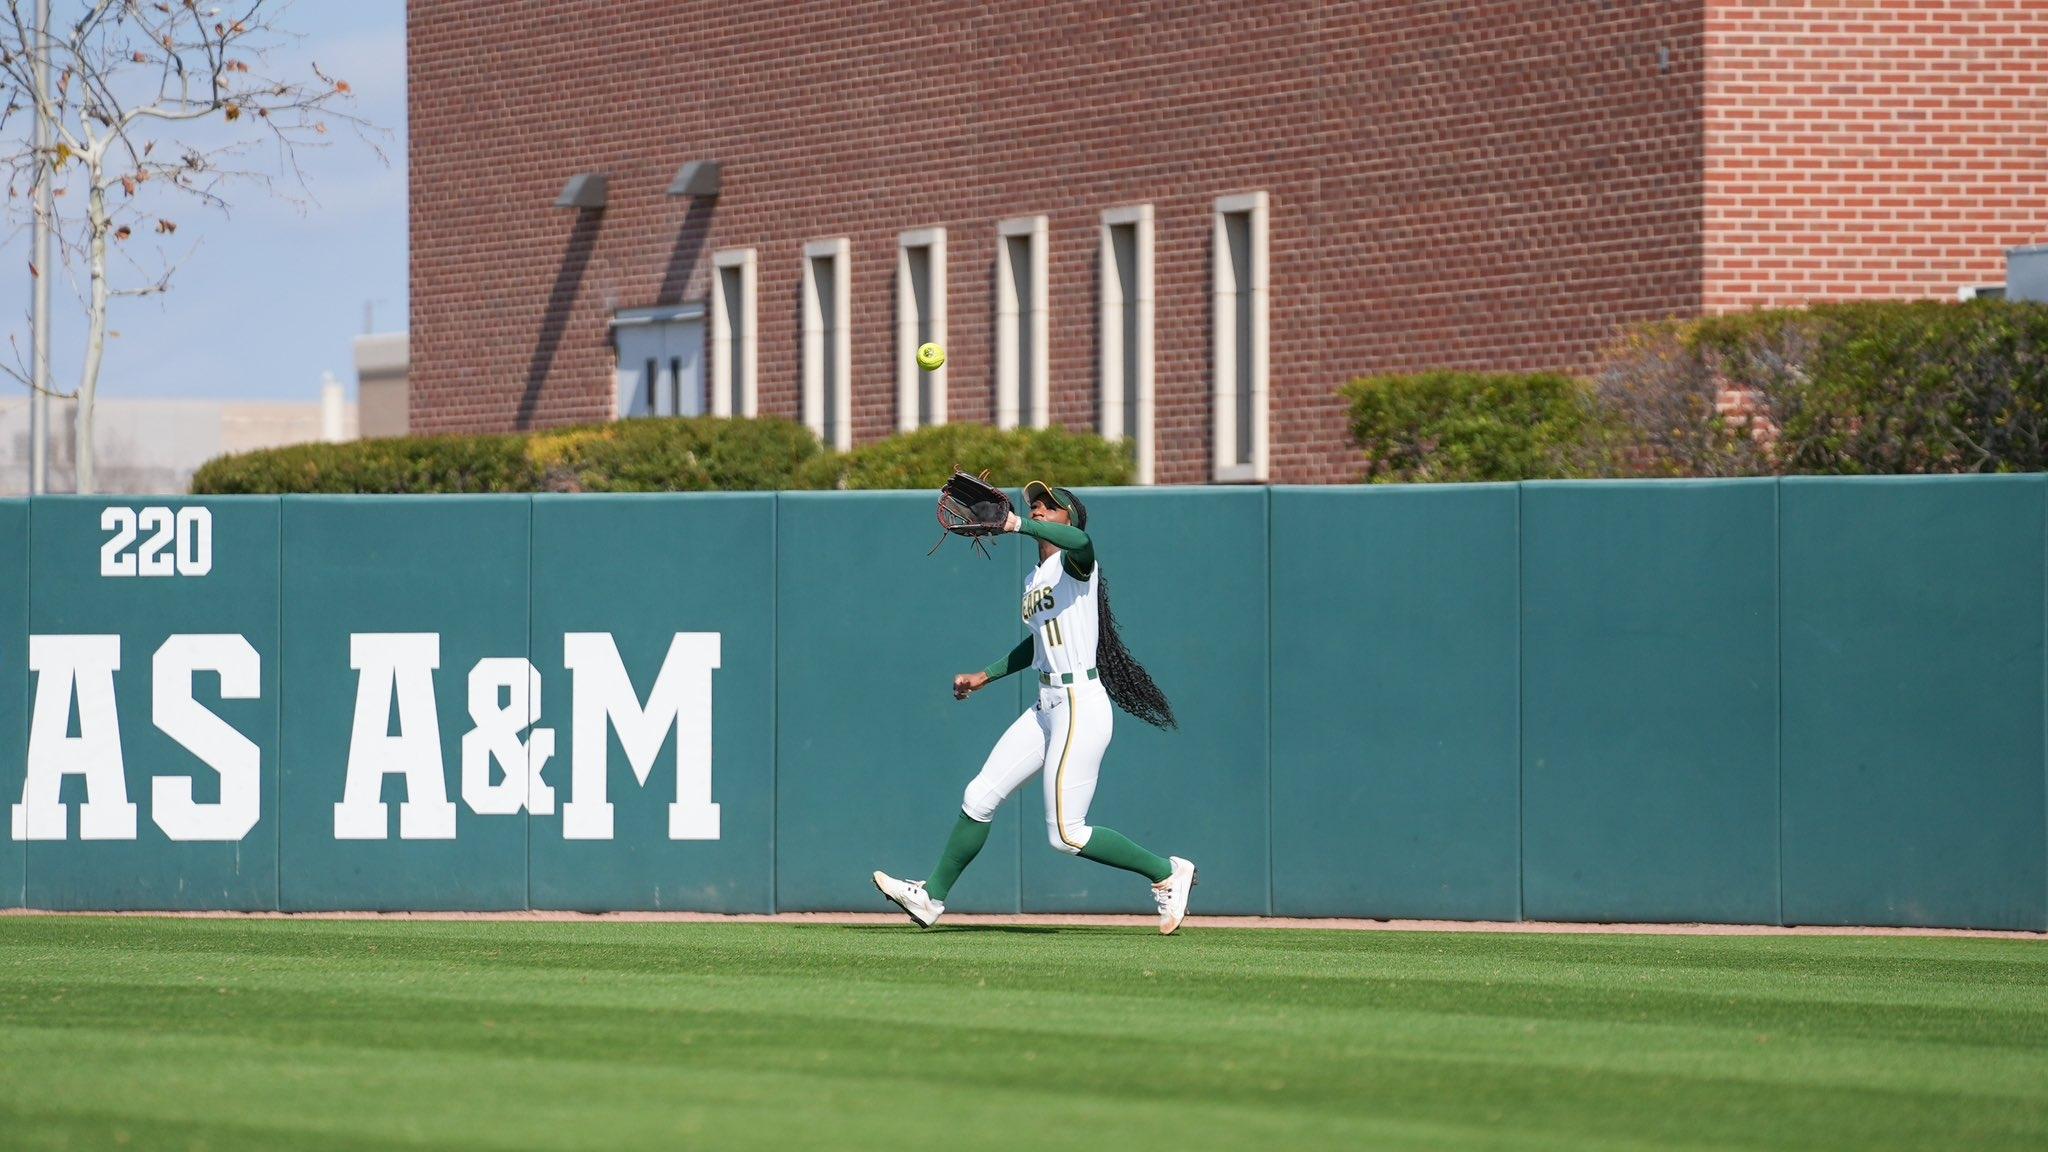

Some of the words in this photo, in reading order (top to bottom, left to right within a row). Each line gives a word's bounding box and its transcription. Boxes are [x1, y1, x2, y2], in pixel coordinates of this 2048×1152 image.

[100, 506, 212, 577] 220
[1044, 617, 1062, 647] 11
[11, 633, 261, 841] AS
[333, 631, 721, 840] A&M
